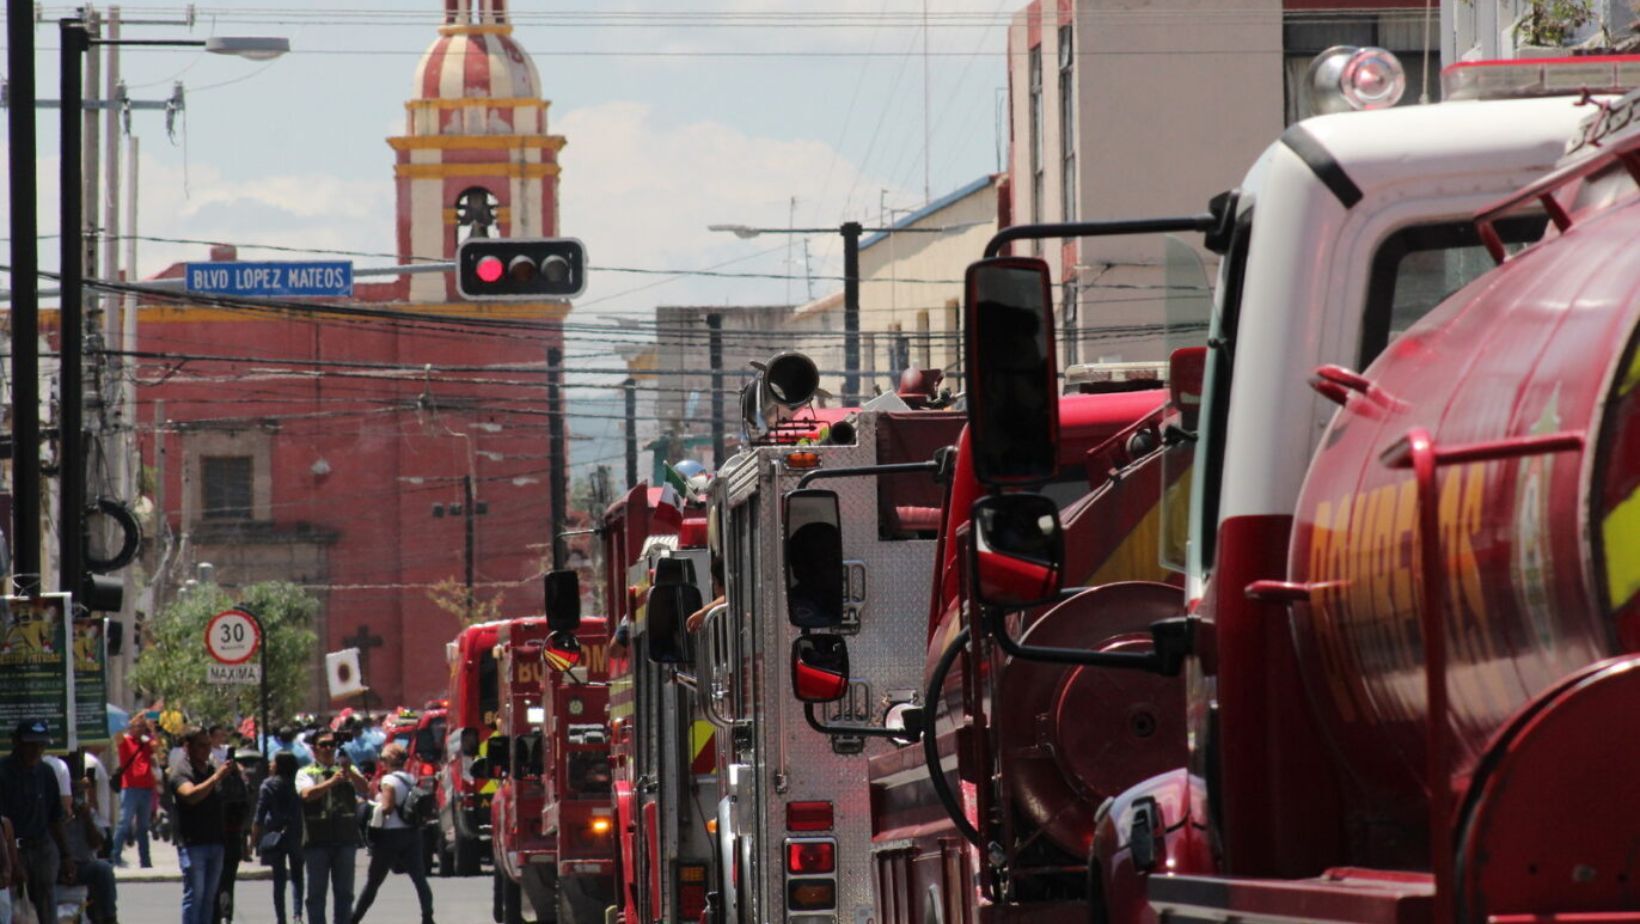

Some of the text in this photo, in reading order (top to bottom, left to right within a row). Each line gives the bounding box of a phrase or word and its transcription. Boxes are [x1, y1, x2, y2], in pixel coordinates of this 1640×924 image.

[193, 268, 344, 289] BLVD LOPEZ MATEOS
[220, 623, 245, 643] 30
